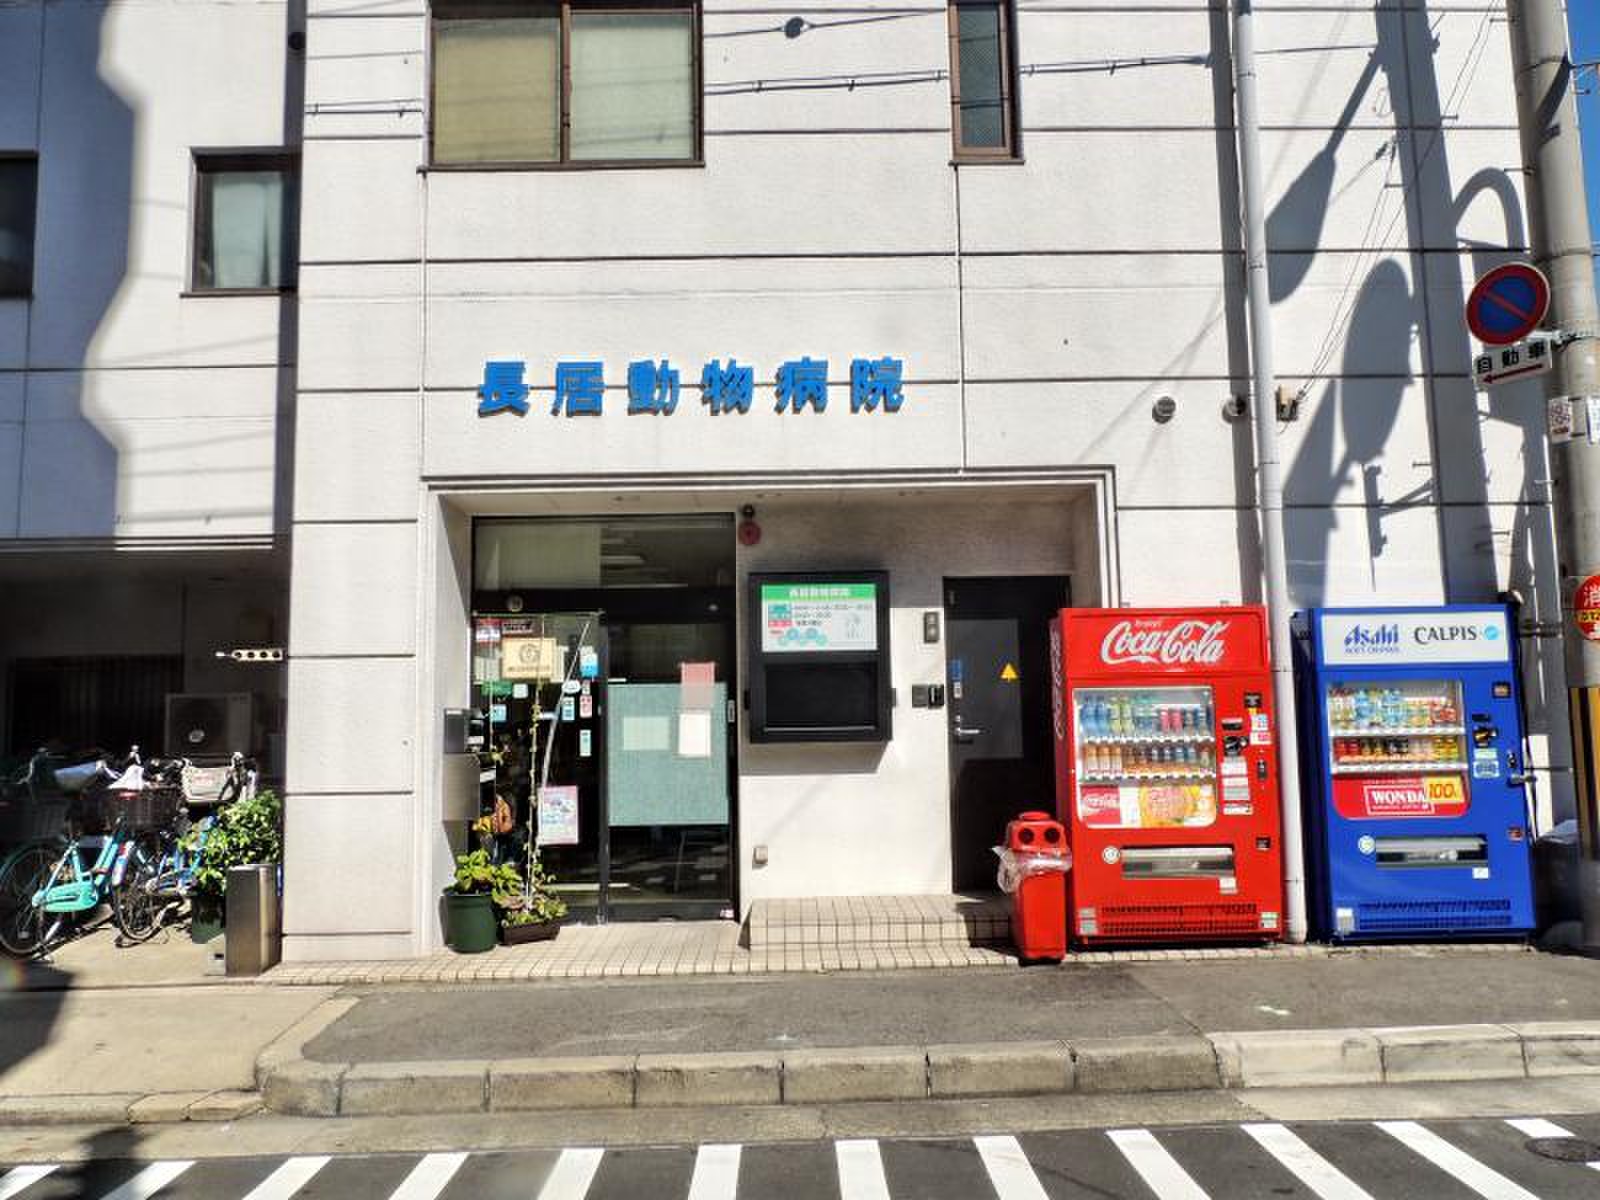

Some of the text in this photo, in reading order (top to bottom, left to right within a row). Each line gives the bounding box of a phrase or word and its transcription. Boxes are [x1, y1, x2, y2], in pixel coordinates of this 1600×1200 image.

[1477, 341, 1545, 375] 自動車
[478, 356, 903, 415] 長居動物病院
[1101, 620, 1230, 664] Coca-Cola
[1344, 623, 1477, 646] Asahi CALPIS
